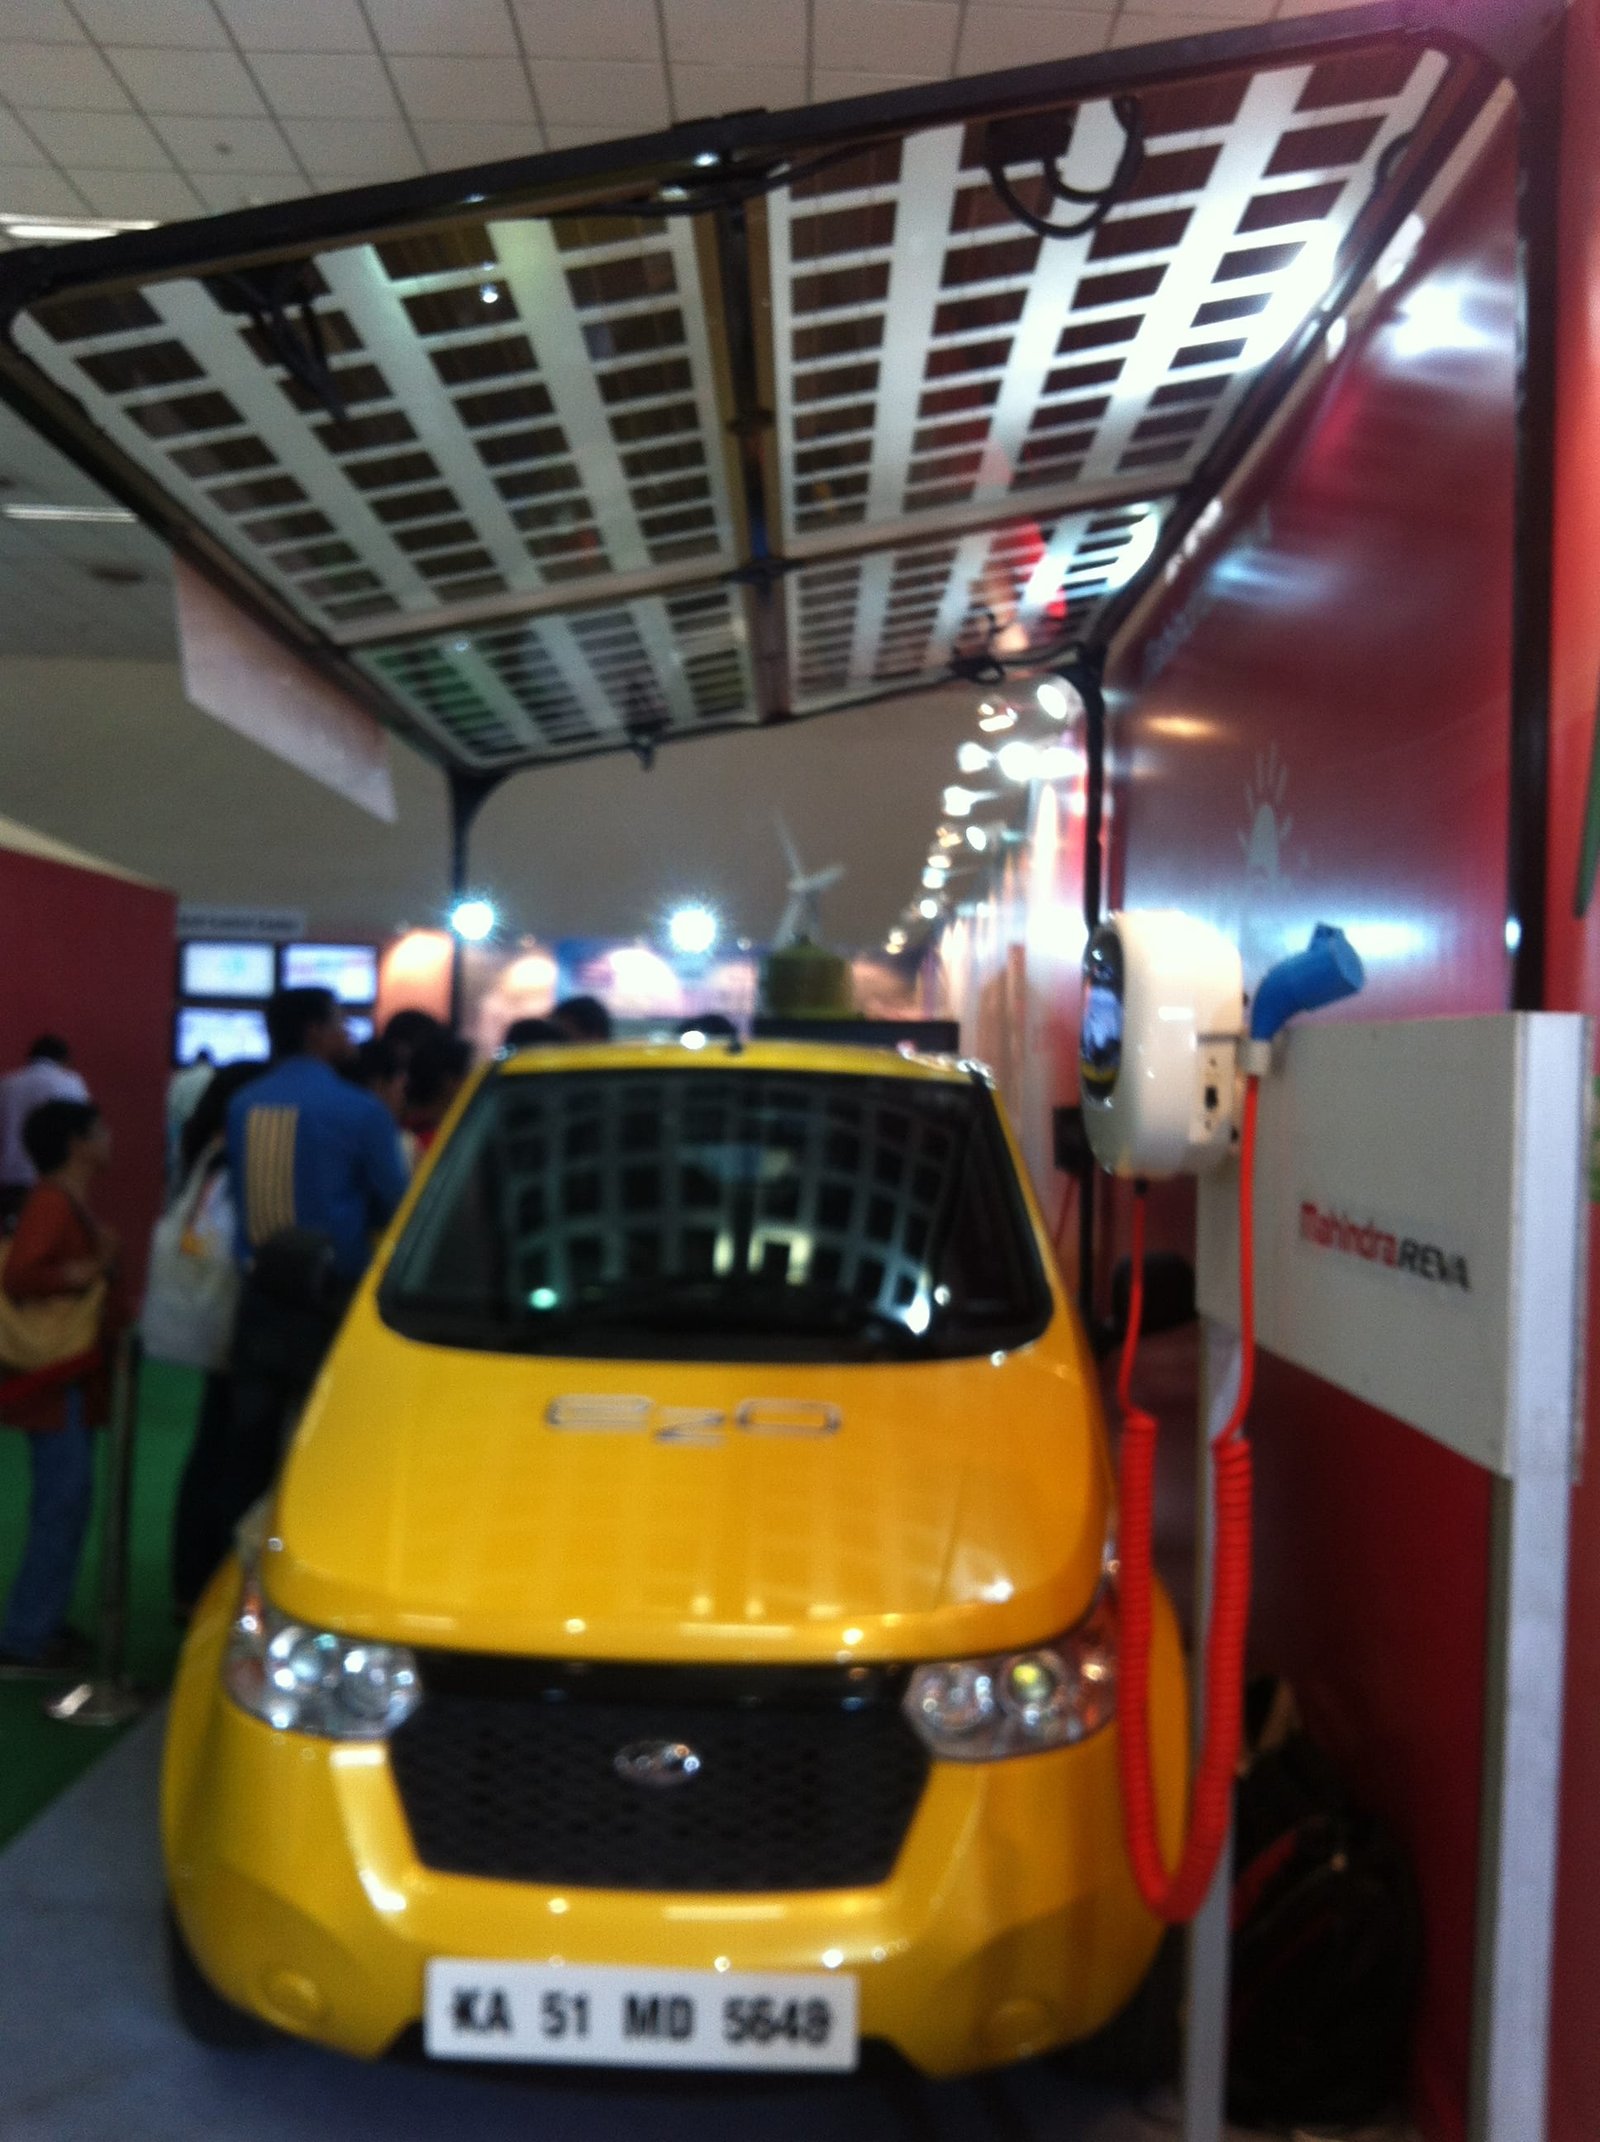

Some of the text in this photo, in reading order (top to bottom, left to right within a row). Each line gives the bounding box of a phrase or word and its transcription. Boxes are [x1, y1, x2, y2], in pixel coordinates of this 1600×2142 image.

[451, 1986, 512, 2034] KA
[541, 1989, 588, 2038] 51
[623, 1992, 693, 2042] MD
